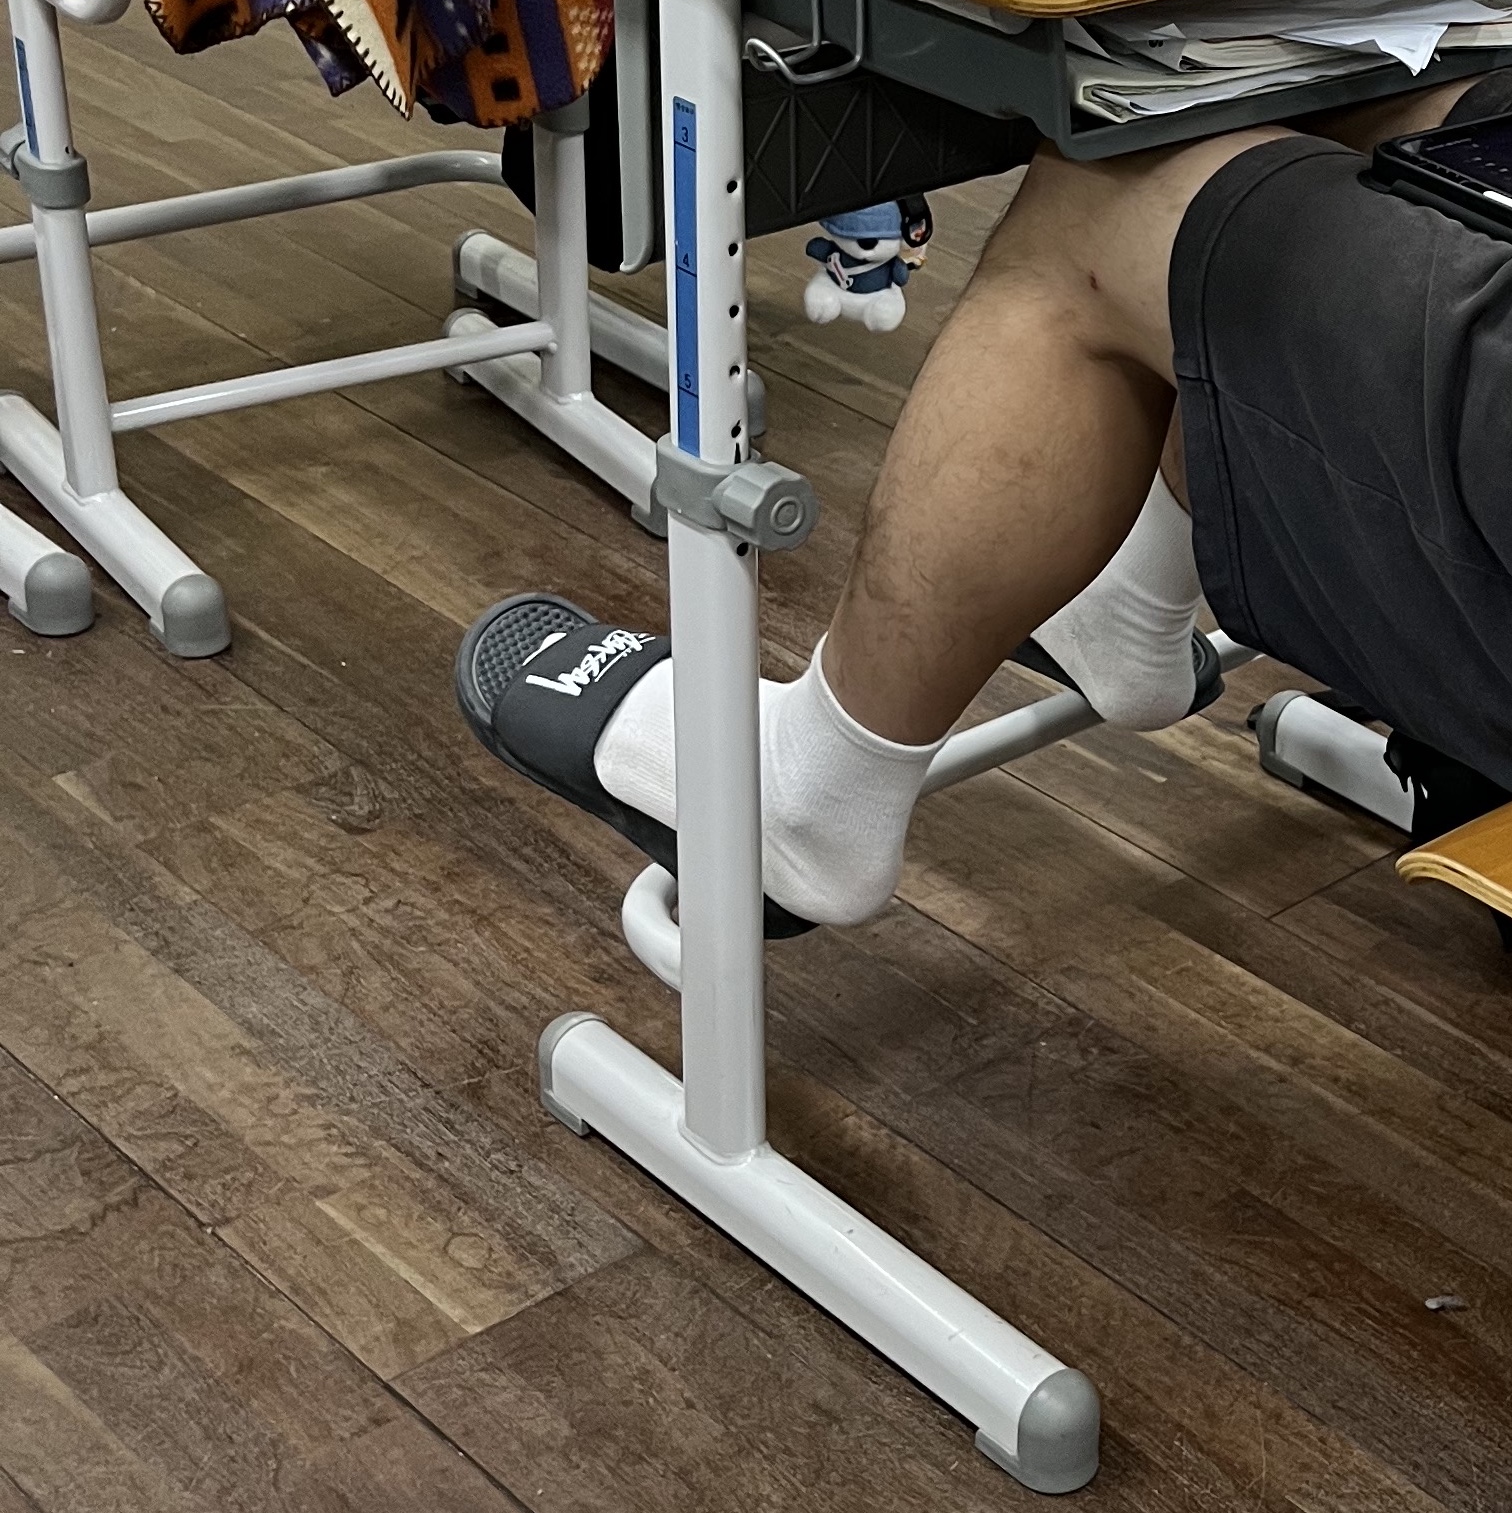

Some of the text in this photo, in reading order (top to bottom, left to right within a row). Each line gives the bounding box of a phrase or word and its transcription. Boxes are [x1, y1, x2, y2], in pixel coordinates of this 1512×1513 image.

[681, 126, 689, 143] 3
[682, 252, 690, 268] 4
[684, 373, 692, 389] 5
